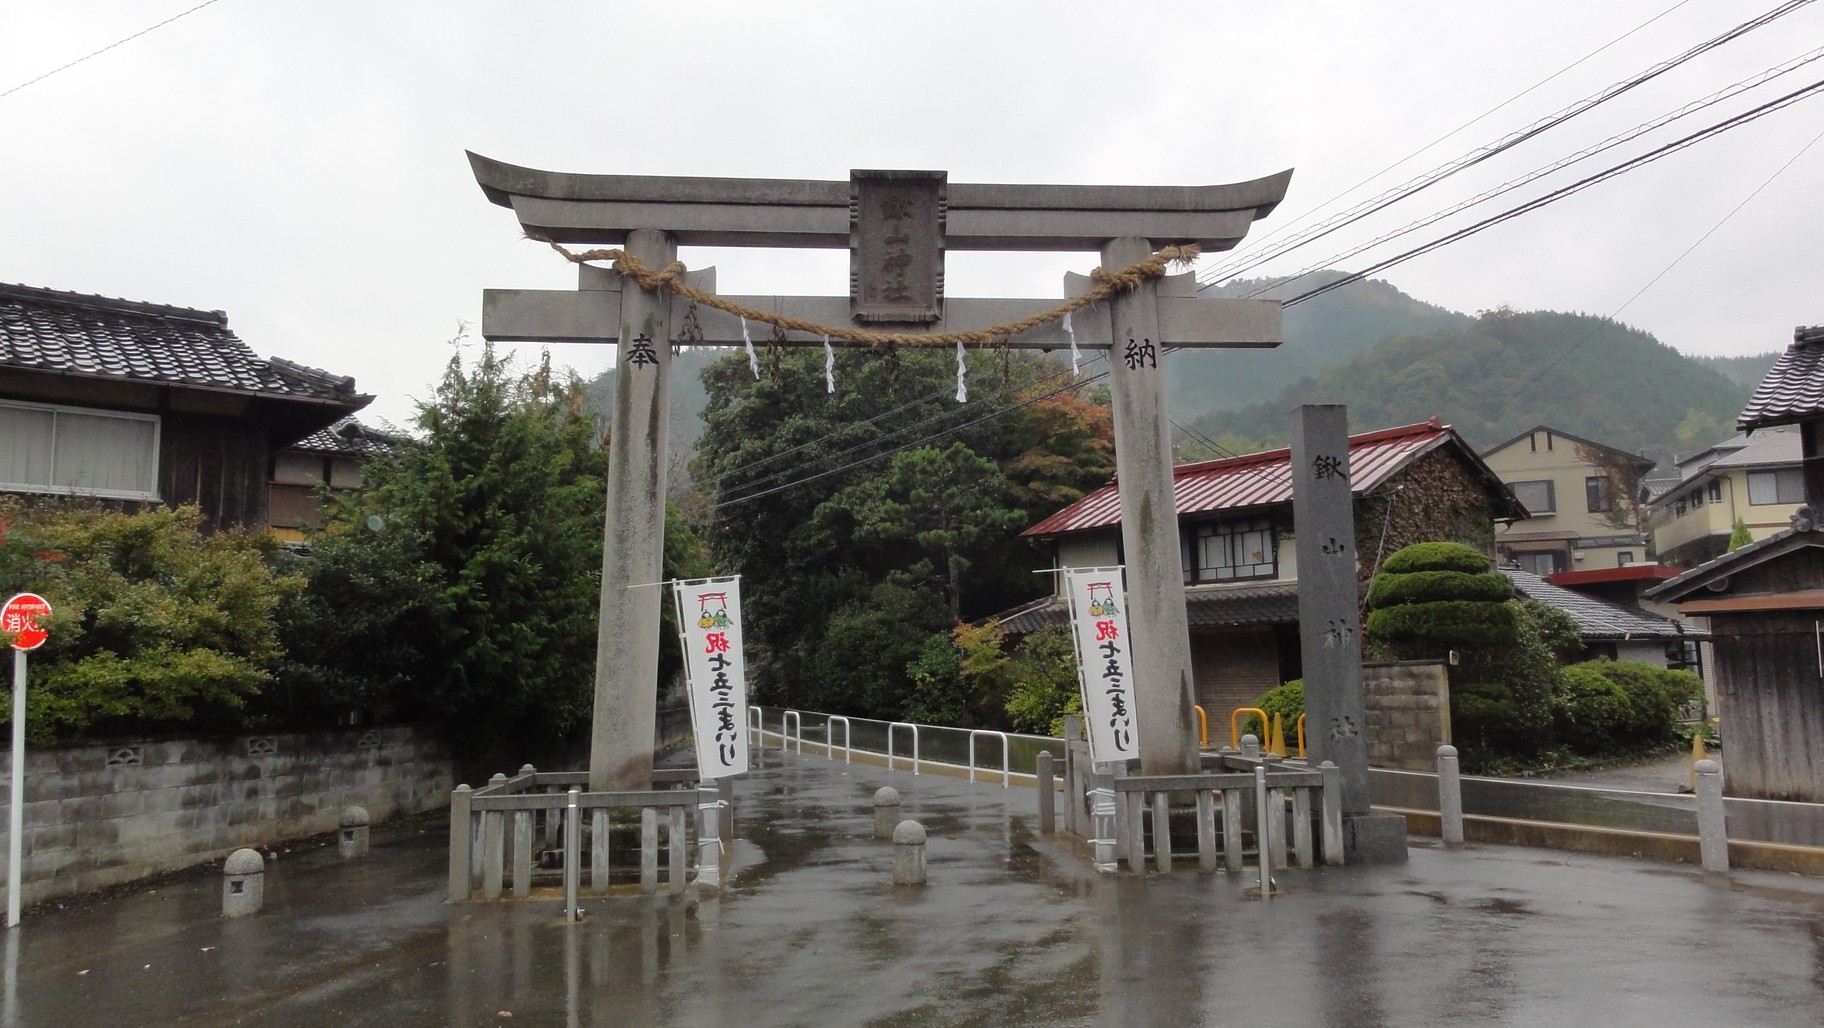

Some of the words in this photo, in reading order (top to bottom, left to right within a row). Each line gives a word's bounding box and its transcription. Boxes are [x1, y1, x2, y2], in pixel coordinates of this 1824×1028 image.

[625, 332, 660, 371] 奉
[1123, 338, 1157, 371] 納
[6, 612, 45, 633] 消火
